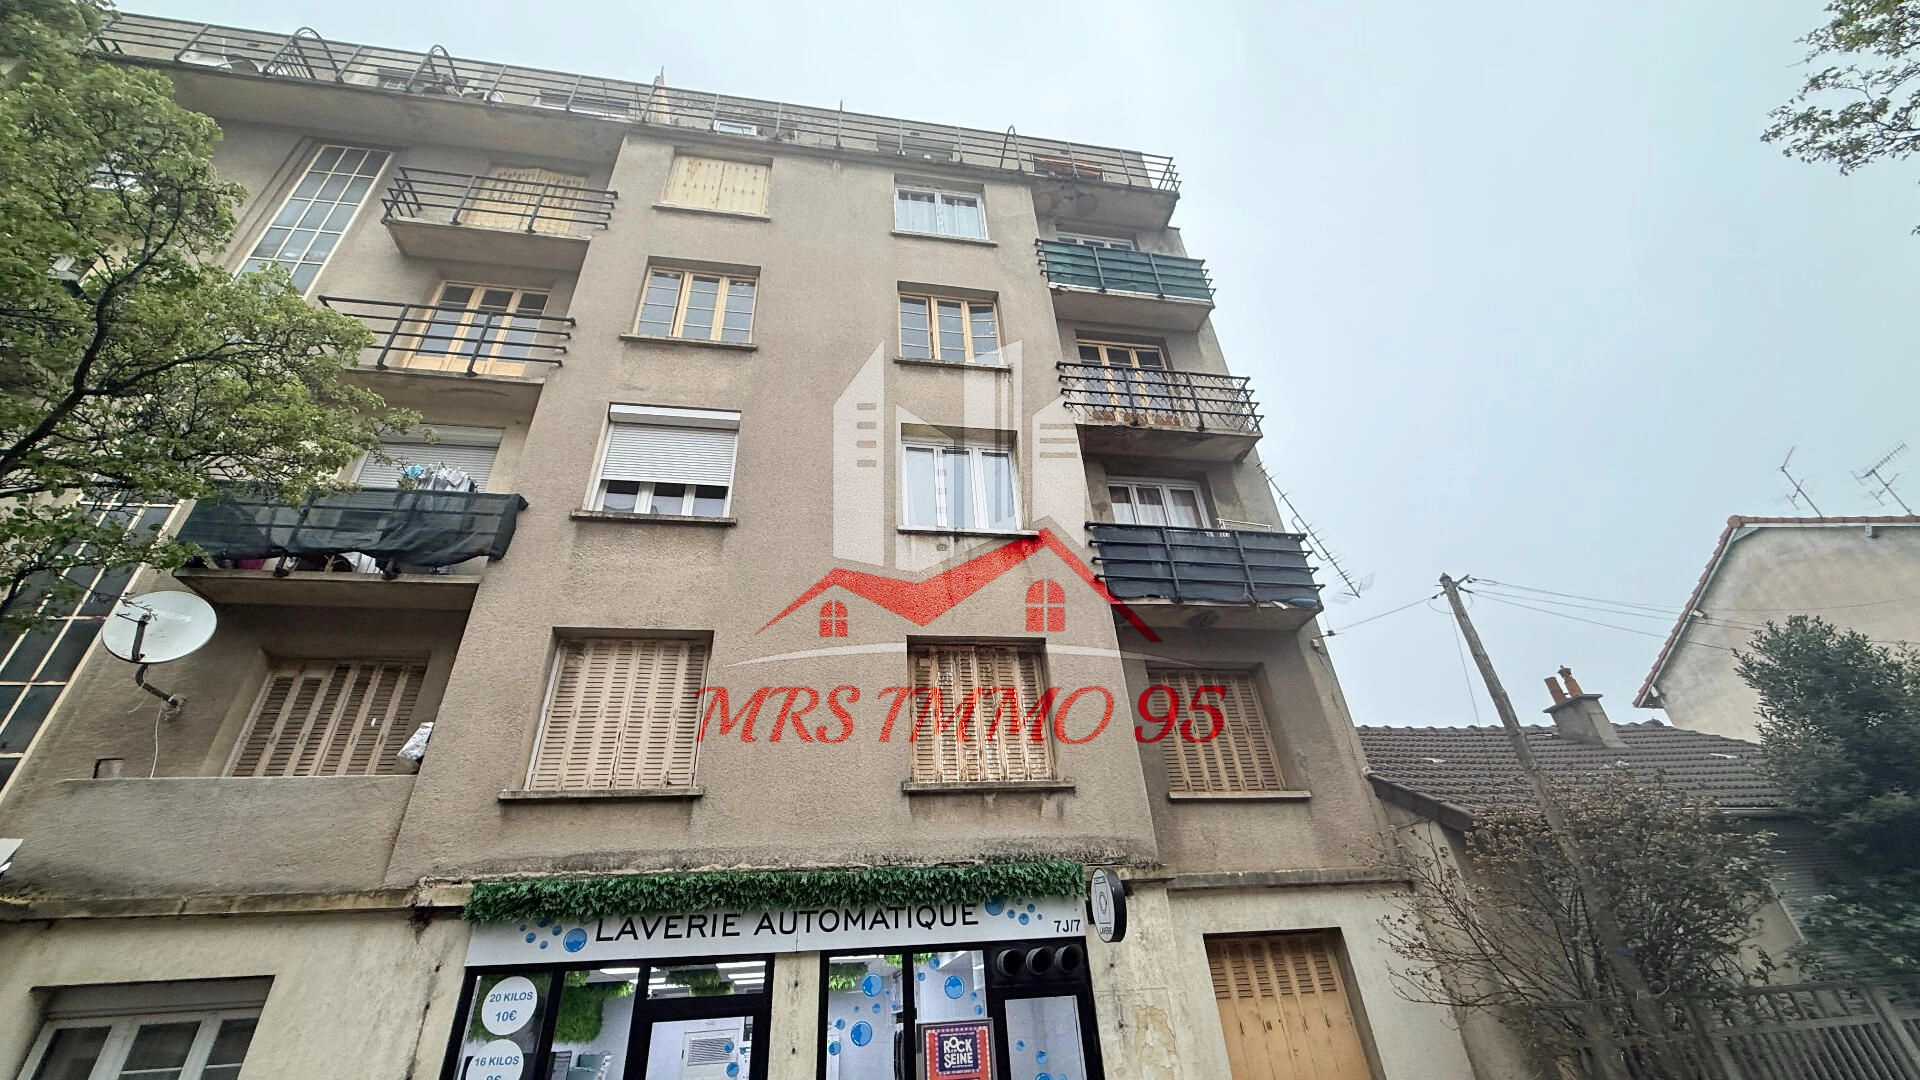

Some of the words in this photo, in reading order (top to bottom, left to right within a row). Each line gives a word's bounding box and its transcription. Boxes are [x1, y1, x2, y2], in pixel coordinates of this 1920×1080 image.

[595, 913, 741, 942] LAVERIE
[753, 903, 979, 935] AUTOMATIQUE
[489, 993, 502, 1003] 20
[503, 992, 533, 1002] KILOS
[495, 1010, 517, 1022] 10€
[943, 1036, 973, 1053] ROCK
[475, 1057, 487, 1067] 16
[488, 1055, 520, 1066] KILOS
[943, 1053, 973, 1068] SEINE
